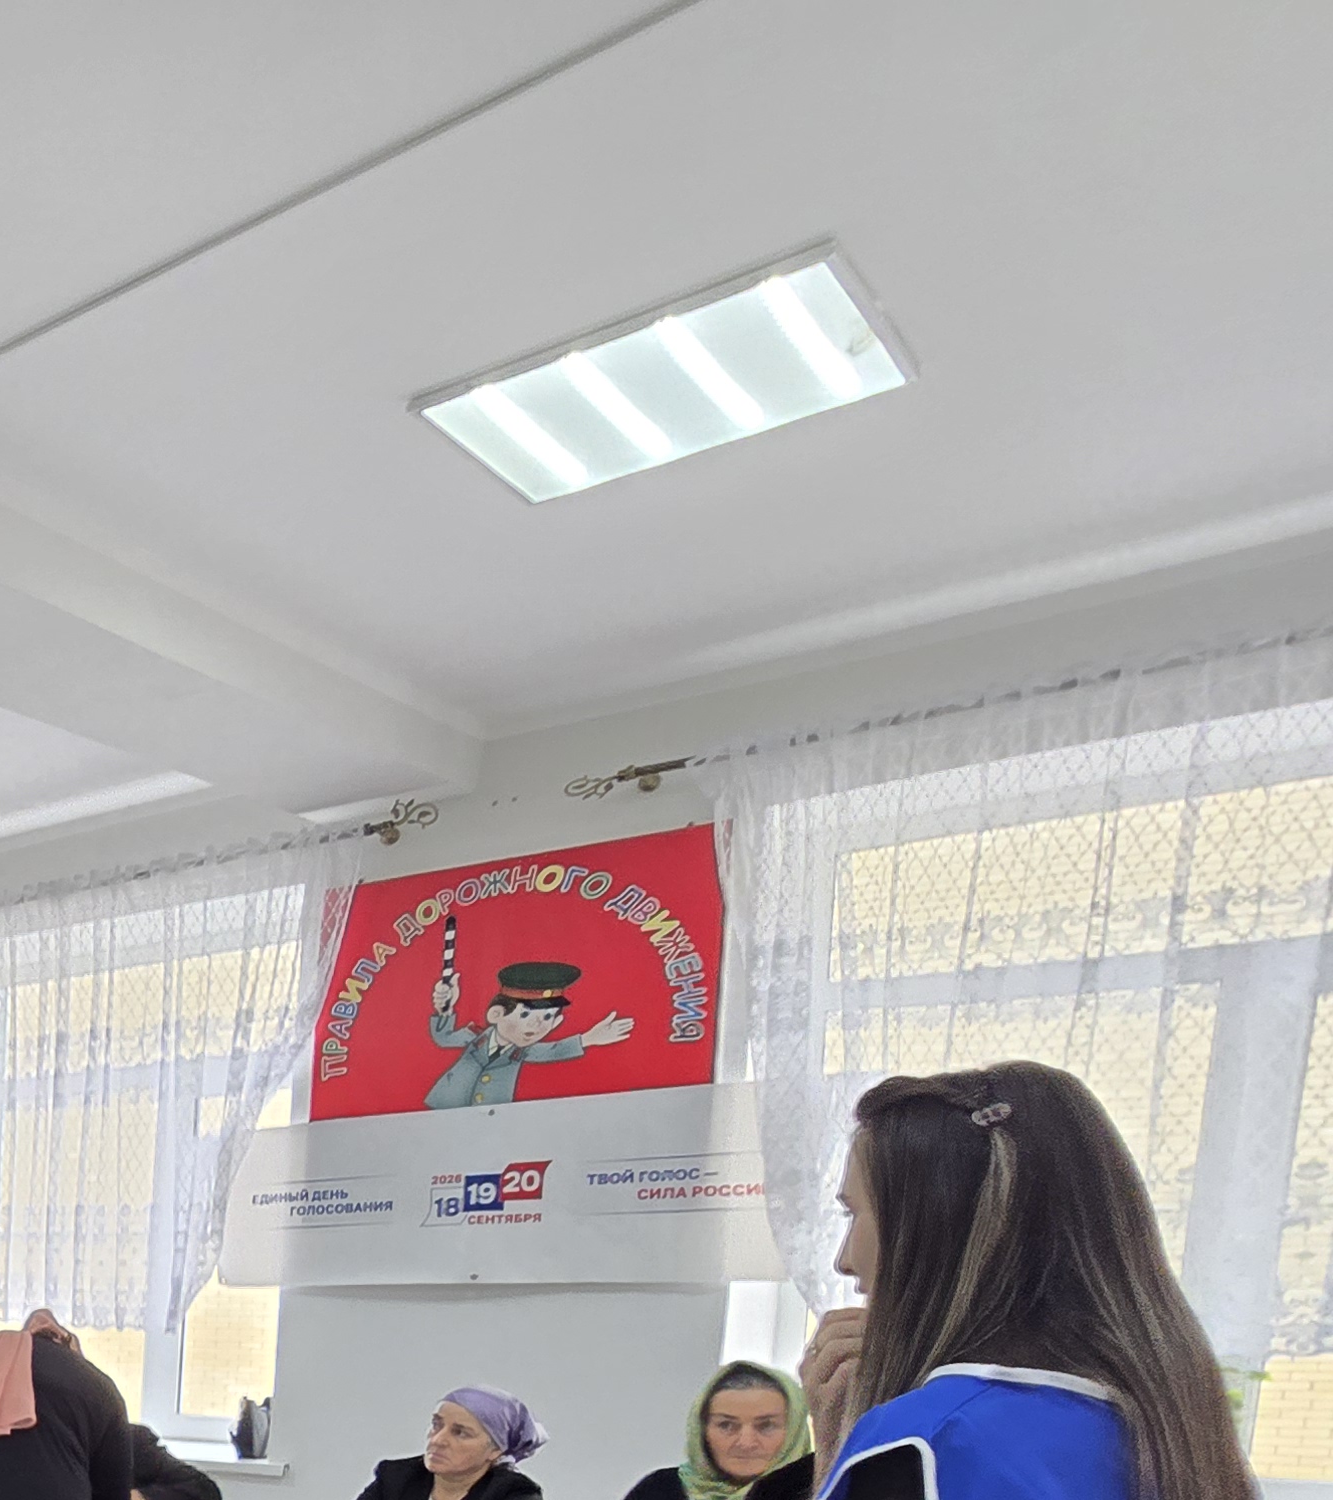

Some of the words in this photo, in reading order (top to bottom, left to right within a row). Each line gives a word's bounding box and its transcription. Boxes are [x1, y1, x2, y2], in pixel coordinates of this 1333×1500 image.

[321, 942, 396, 1082] ПРАВИЛА
[393, 865, 613, 946] ДОРОЖНОГО
[604, 884, 708, 1042] ДВИЖЕНИЯ
[431, 1174, 462, 1185] 2026
[587, 1169, 634, 1185] ТВОЙ
[639, 1168, 700, 1183] ГОЛОС
[252, 1188, 309, 1205] ЕДИНЫЙ
[311, 1188, 348, 1203] ДЕНЬ
[435, 1197, 460, 1218] 18
[467, 1183, 497, 1205] 19
[502, 1170, 540, 1193] 20
[637, 1187, 687, 1200] СИЛА
[692, 1183, 765, 1198] РОССИ
[290, 1201, 393, 1217] ГОЛОСОВАНИЯ
[468, 1213, 542, 1225] СЕНТЯБРЯ
